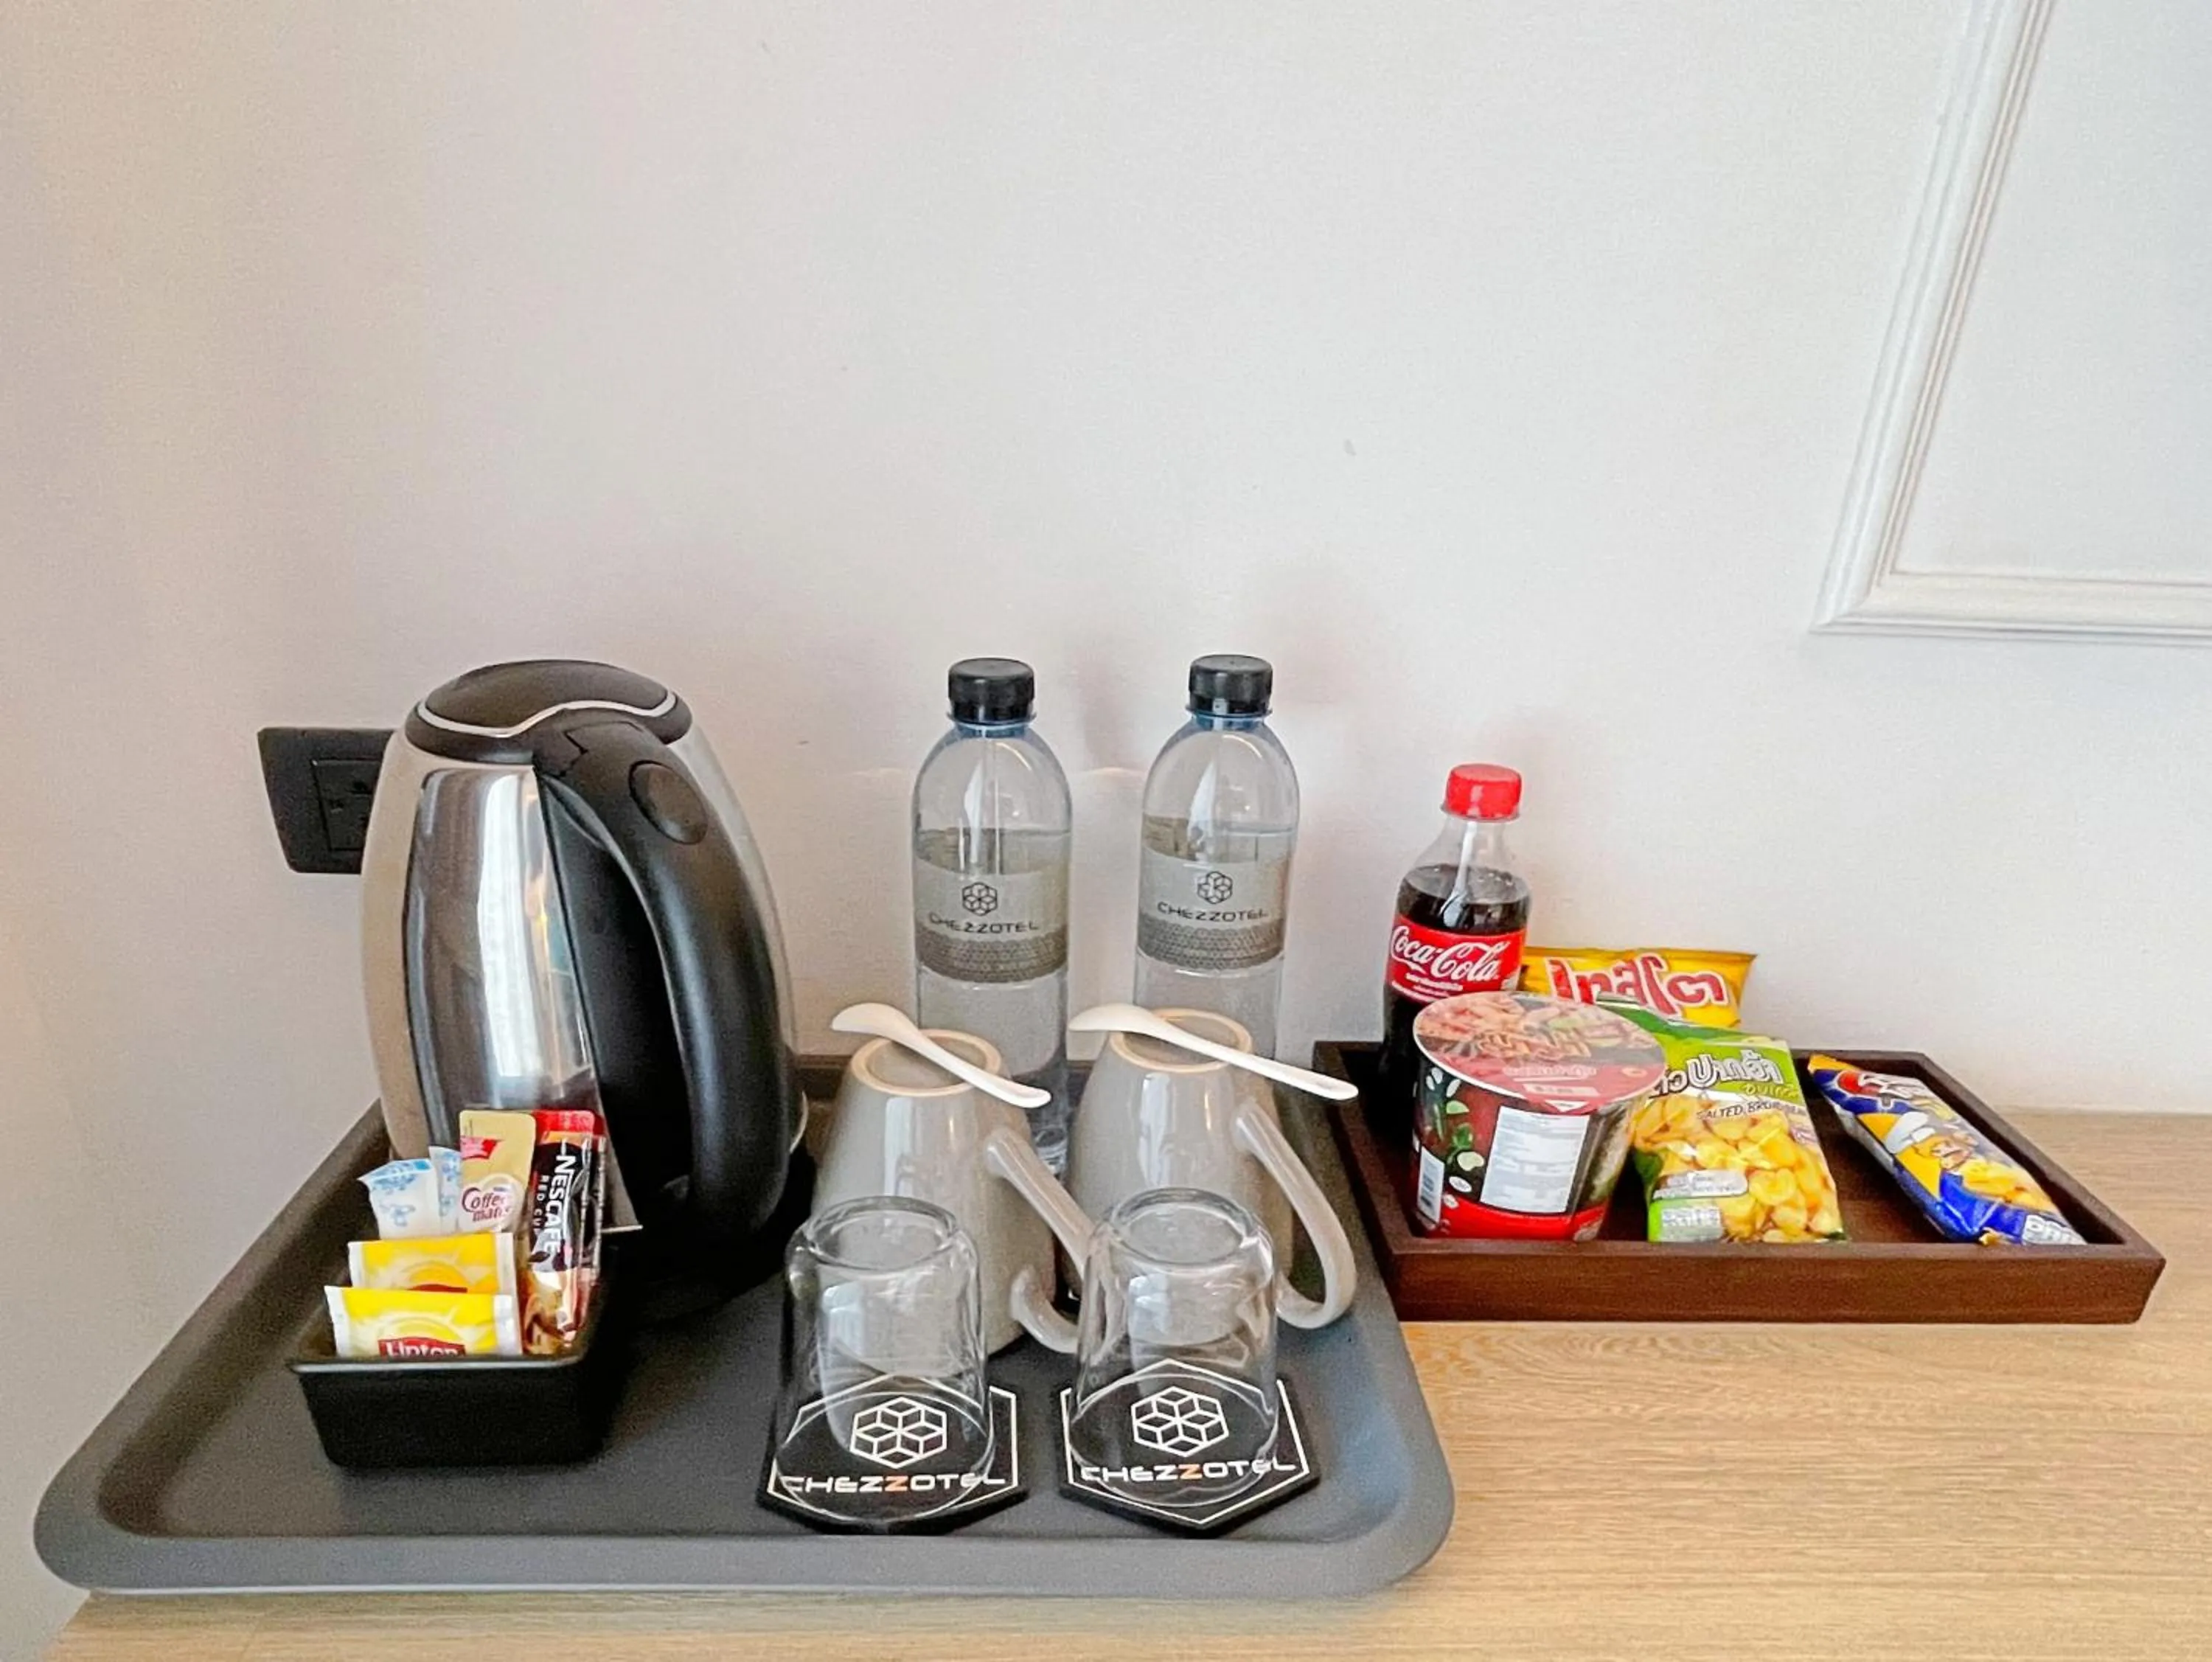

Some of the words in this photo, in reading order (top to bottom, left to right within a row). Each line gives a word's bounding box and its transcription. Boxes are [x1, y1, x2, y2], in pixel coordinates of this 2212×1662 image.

[1157, 902, 1268, 922] CHEZZOTEL
[929, 914, 1039, 934] CHEZZOTEL
[1391, 925, 1511, 981] Coca-Cola
[1080, 1456, 1295, 1482] CHEZZOTEL
[780, 1472, 1006, 1493] CHEZZOTEL
